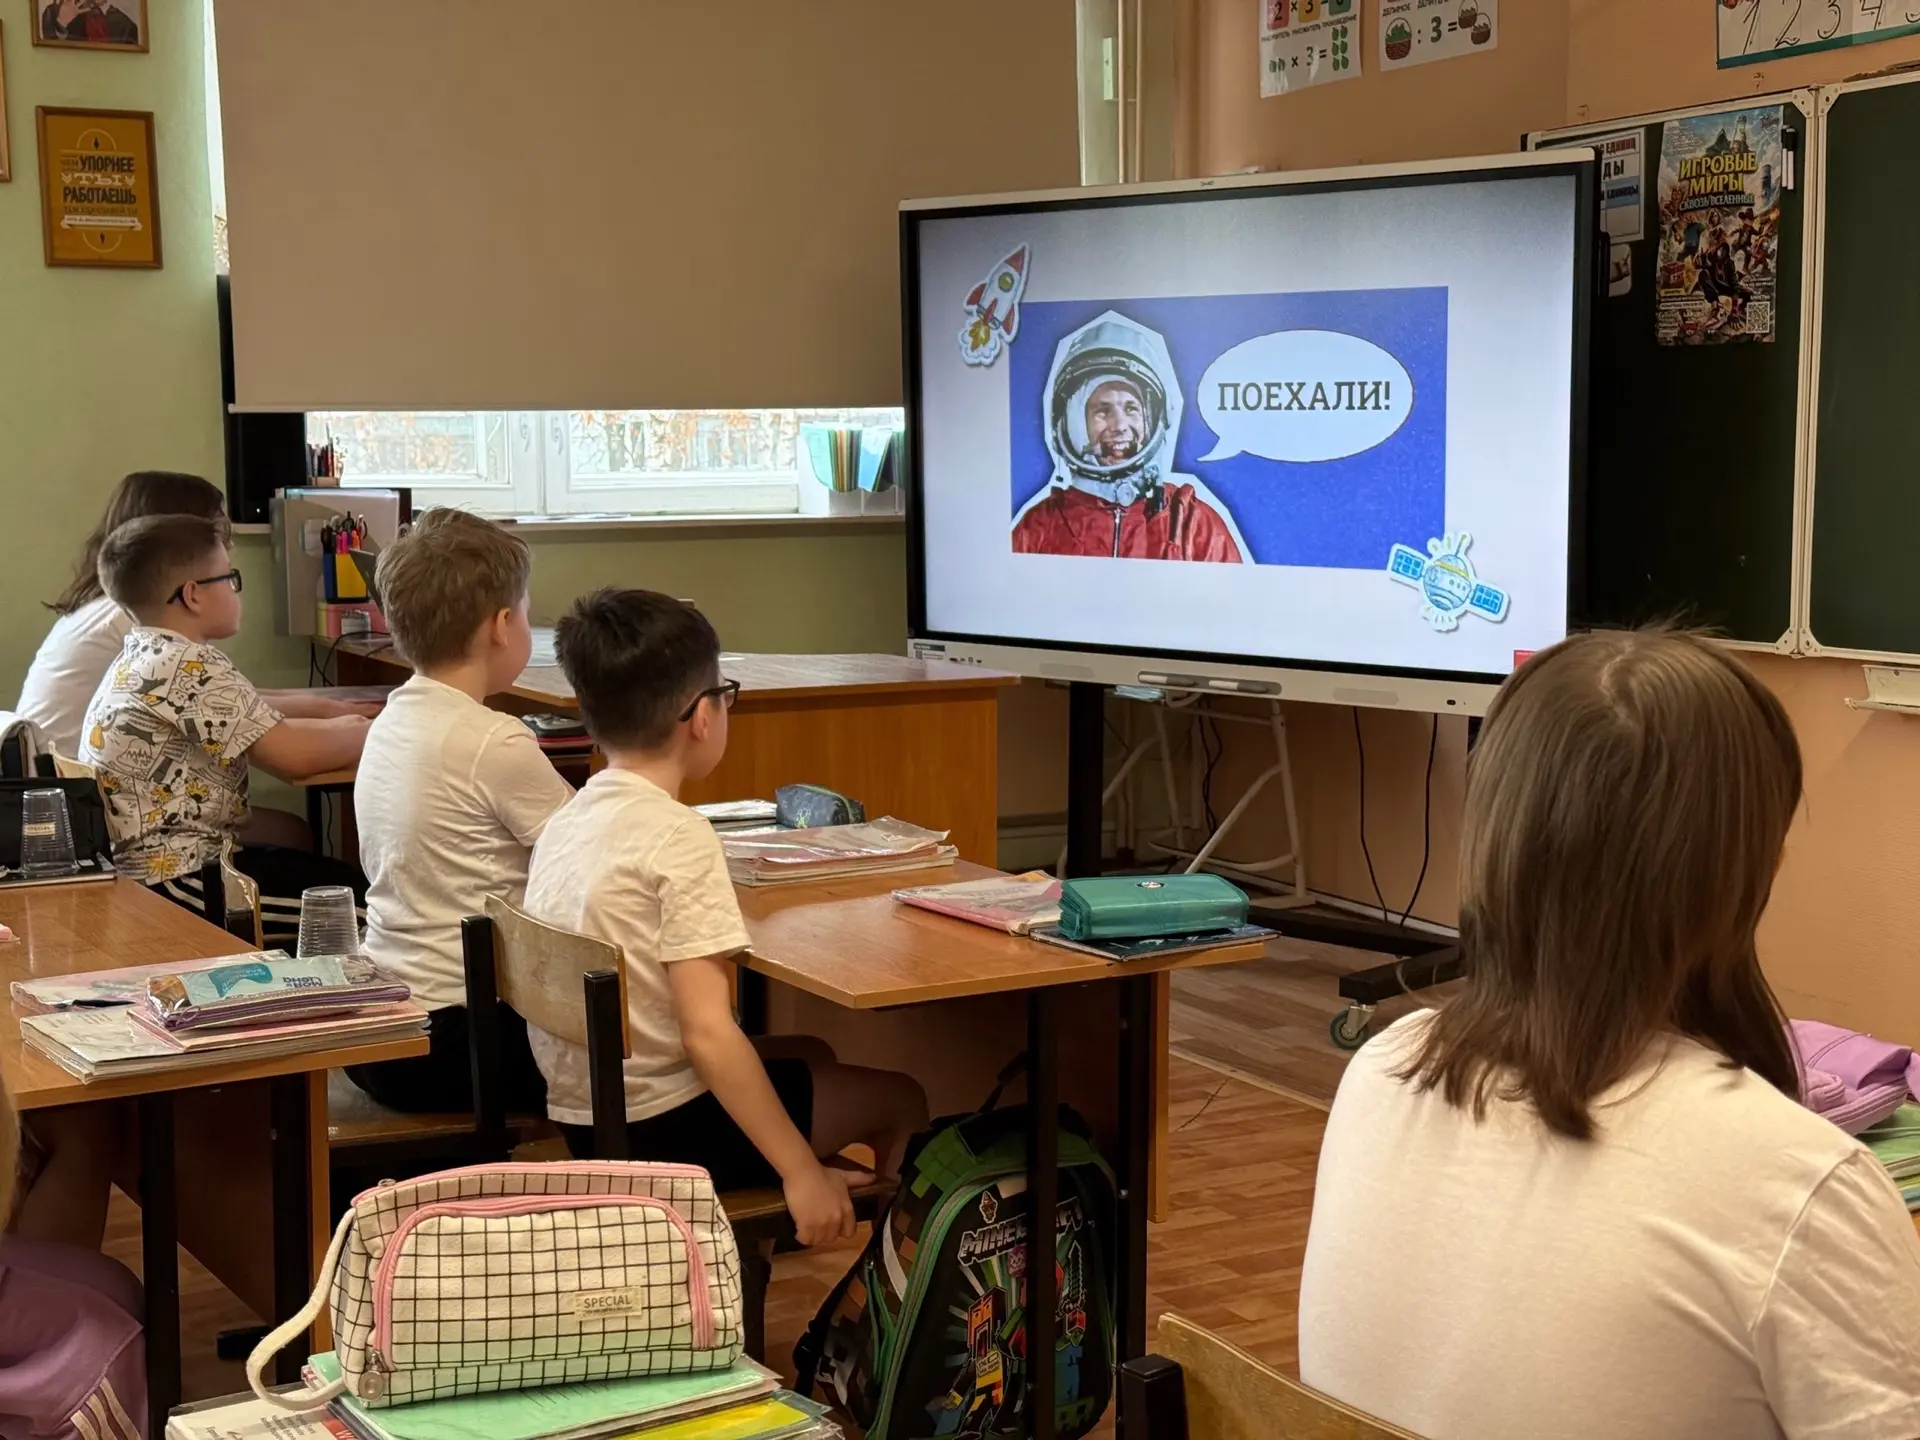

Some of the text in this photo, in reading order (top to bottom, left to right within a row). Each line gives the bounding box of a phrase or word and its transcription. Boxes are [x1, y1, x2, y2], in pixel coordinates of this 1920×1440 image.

[1430, 16, 1442, 42] 3
[1774, 0, 1801, 48] 2
[1817, 0, 1842, 39] 3
[79, 155, 135, 173] УПОРНЕЕ
[1679, 152, 1757, 179] ИГРОВЫЕ
[74, 172, 122, 186] ТЫ
[1689, 172, 1745, 196] МИРЫ
[63, 186, 137, 205] РАБОТАЕШЬ
[1679, 196, 1709, 211] СКВОЗЬ
[1217, 380, 1391, 411] ПОЕХАЛИ!
[584, 1295, 631, 1308] SPECIAL
